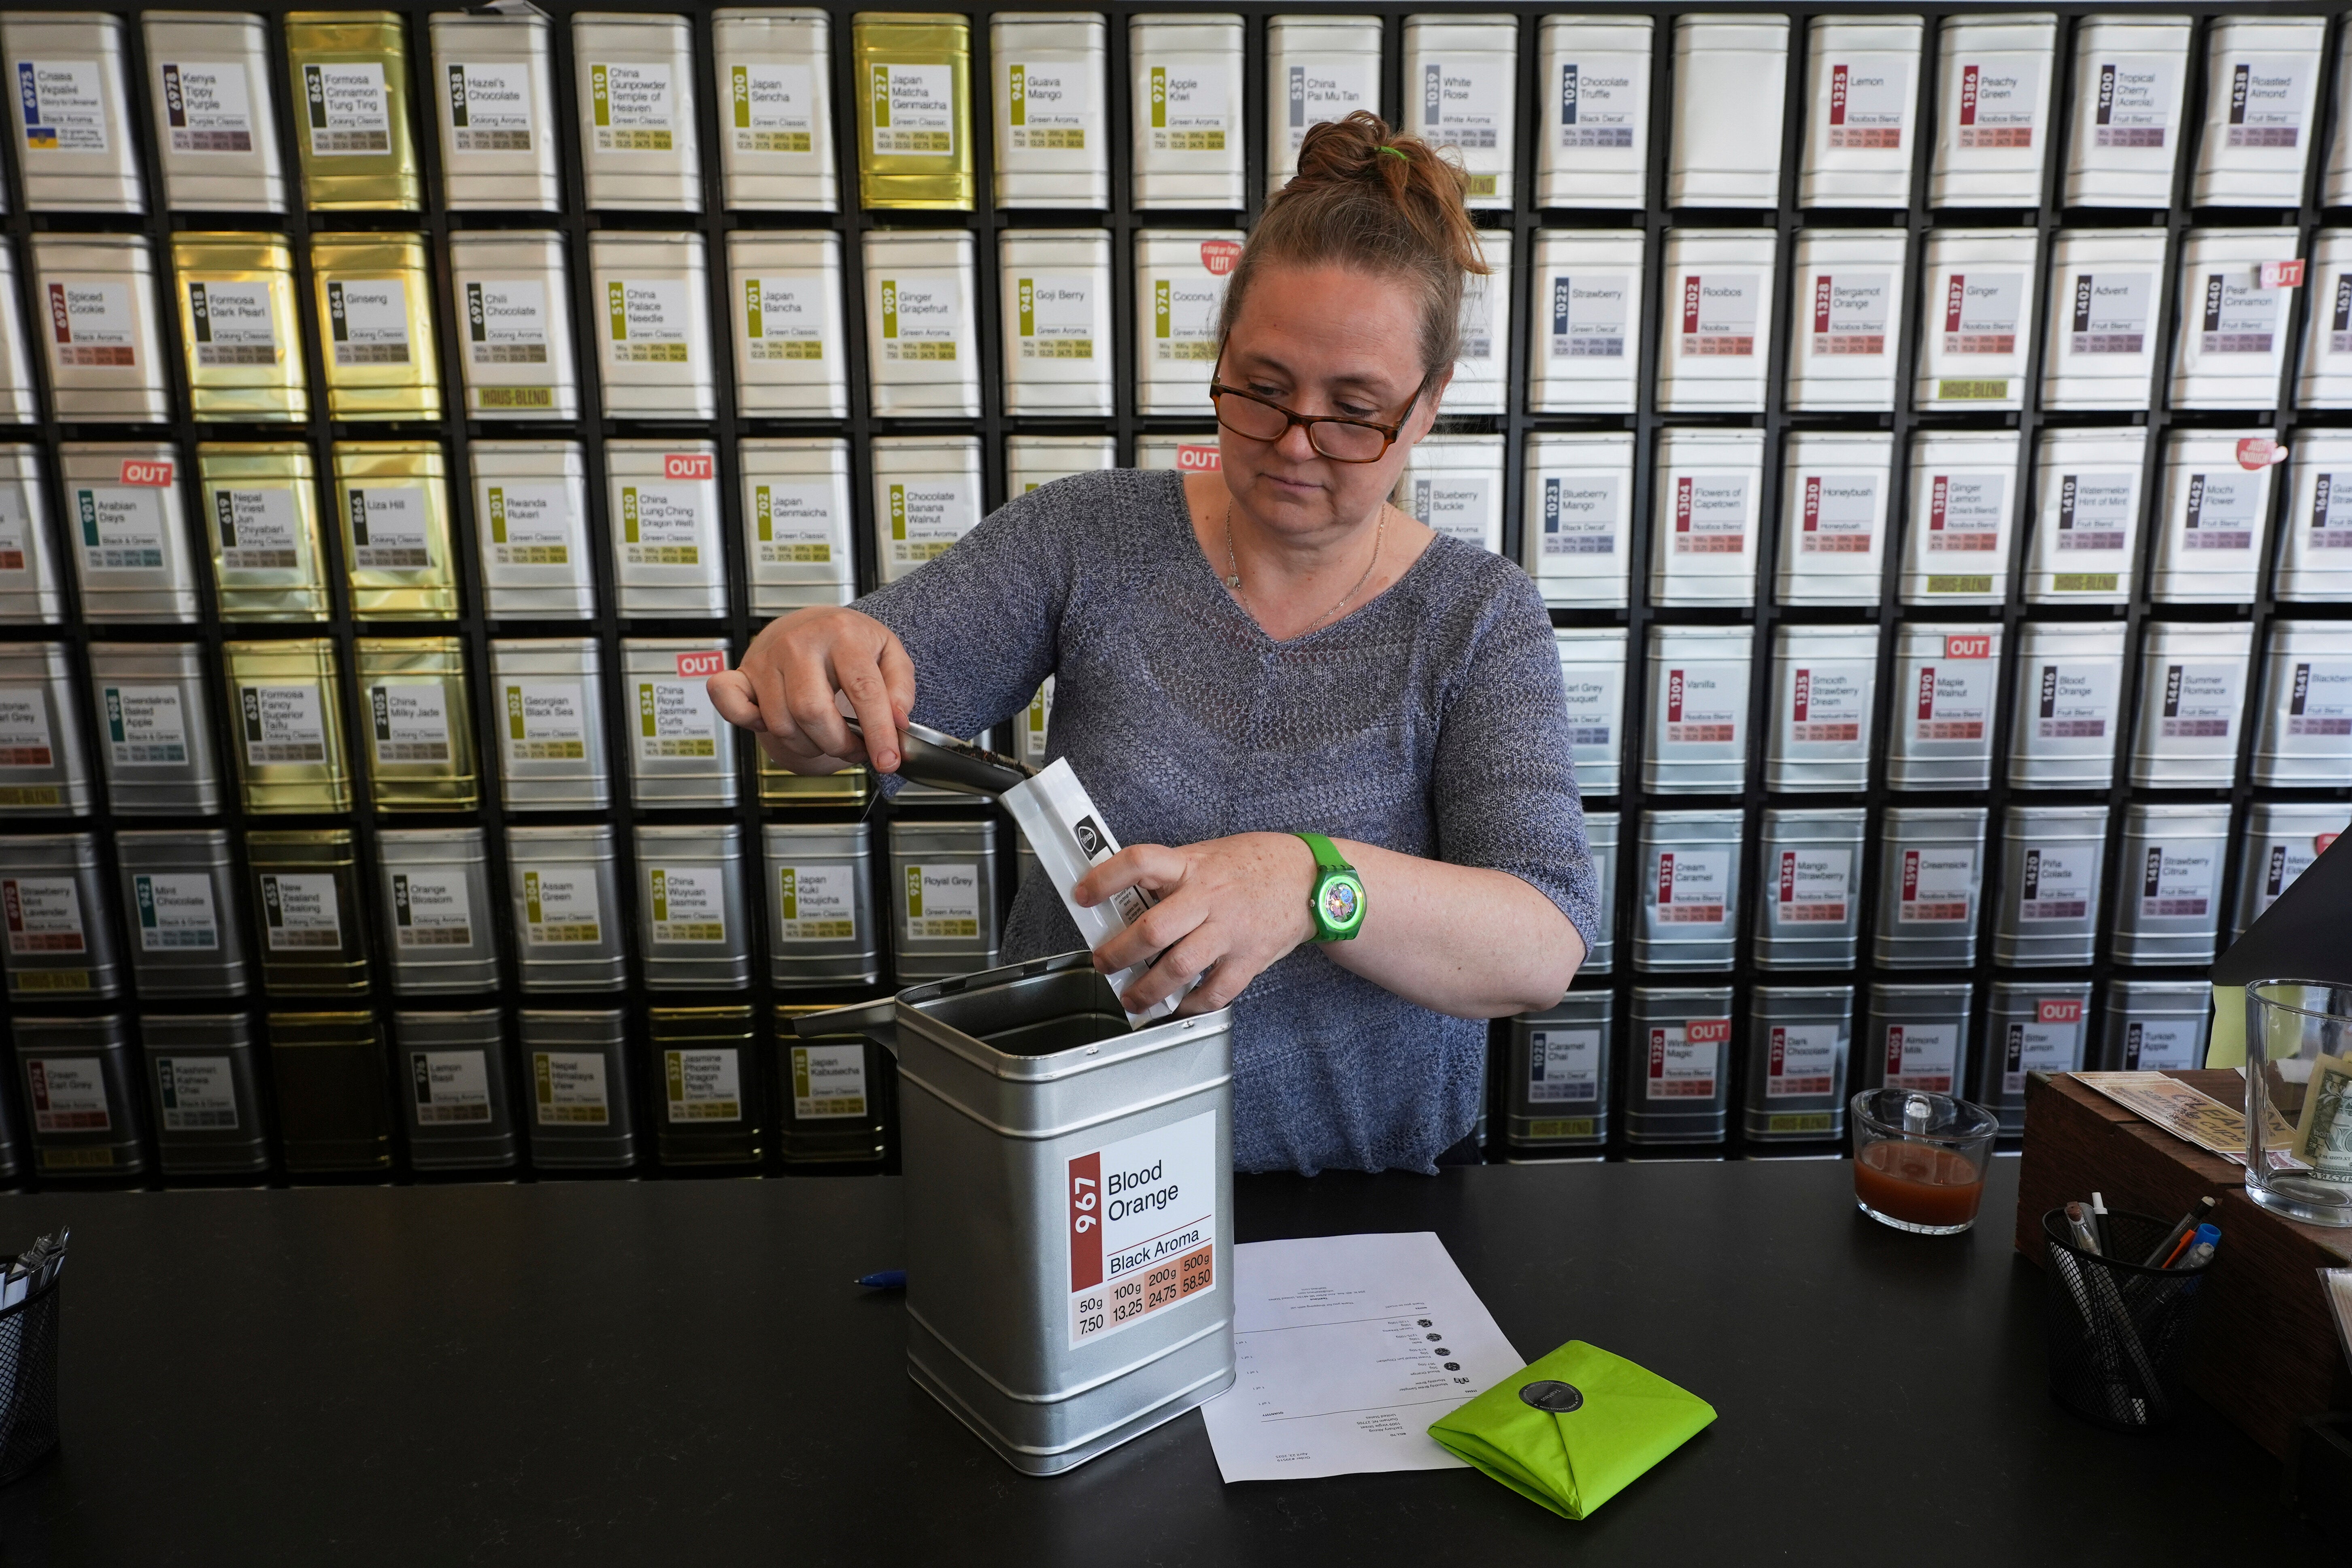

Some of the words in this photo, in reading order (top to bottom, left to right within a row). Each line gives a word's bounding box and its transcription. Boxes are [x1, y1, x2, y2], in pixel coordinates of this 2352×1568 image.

[610, 68, 640, 79] China
[183, 73, 216, 86] Kenya
[325, 74, 369, 85] Formosa
[610, 79, 666, 91] Gunpowder
[891, 76, 922, 86] Japan
[1028, 77, 1060, 87] Guava
[1169, 79, 1197, 91] Apple
[1580, 77, 1629, 87] Chocolate
[1850, 77, 1884, 86] Lemon
[1981, 77, 2018, 88] Peachy
[166, 72, 181, 111] 6978
[311, 74, 321, 102] 862
[452, 73, 464, 107] 1638
[595, 73, 606, 99] 510
[876, 74, 887, 101] 727
[1012, 73, 1023, 100] 945
[1153, 75, 1163, 103] 973
[1564, 73, 1576, 105] 1021
[1833, 73, 1846, 107] 1325
[1963, 74, 1978, 109] 1386
[184, 86, 213, 98] Tippy
[326, 87, 378, 98] Cinnamon
[468, 90, 520, 100] Chocolate
[612, 91, 648, 103] Temple
[651, 91, 661, 102] of
[892, 87, 929, 97] Matcha
[1028, 90, 1062, 101] Mango
[1170, 91, 1190, 100] Kiwi
[1581, 89, 1610, 99] Truffle
[1980, 89, 2011, 99] Green
[186, 98, 220, 111] Purple
[328, 100, 353, 112] Tung
[356, 99, 377, 112] Ting
[613, 104, 651, 113] Heaven
[892, 99, 947, 110] Genmaicha
[627, 289, 656, 300] China
[1036, 290, 1056, 301] Goji
[1059, 290, 1084, 301] Berry
[1173, 291, 1214, 301] Coconut
[1703, 287, 1742, 297] Rooibos
[1834, 287, 1880, 298] Bergamot
[485, 295, 507, 304] Chili
[612, 290, 623, 314] 512
[884, 288, 895, 314] 909
[900, 292, 931, 304] Ginger
[1021, 286, 1031, 313] 948
[1157, 289, 1168, 314] 974
[1686, 284, 1699, 316] 1302
[1817, 283, 1830, 317] 1328
[1833, 298, 1869, 309] Orange
[470, 290, 483, 323] 6971
[486, 306, 536, 316] Chocolate
[628, 301, 661, 311] Palace
[900, 304, 947, 314] Grapefruit
[629, 313, 663, 323] Needle
[483, 389, 549, 405] HAUS-BLEND
[127, 464, 168, 483] OUT
[669, 460, 708, 476] OUT
[907, 492, 955, 501] Chocolate
[1563, 490, 1608, 500] Blueberry
[1695, 488, 1729, 497] Flowers
[1732, 487, 1742, 497] of
[507, 498, 547, 508] Rwanda
[640, 495, 667, 504] China
[773, 497, 802, 507] Japan
[1547, 486, 1559, 517] 1023
[1678, 485, 1691, 517] 1304
[1694, 499, 1740, 509] Capetown
[2063, 482, 2076, 515] 1410
[2078, 497, 2096, 506] Hint
[2099, 497, 2108, 506] of
[2109, 497, 2127, 505] Mint
[491, 494, 502, 517] 301
[625, 495, 636, 519] 520
[759, 494, 769, 517] 702
[893, 492, 903, 517] 919
[908, 504, 944, 513] Banana
[1563, 501, 1594, 512] Mango
[640, 507, 664, 517] Lung
[666, 506, 693, 518] Ching
[774, 508, 827, 518] Genmaicha
[908, 515, 941, 523] Walnut
[1950, 640, 1987, 655] OUT
[682, 656, 720, 673] OUT
[1686, 680, 1716, 689] Vanilla
[1813, 676, 1847, 685] Smooth
[1670, 677, 1682, 707] 1309
[1796, 676, 1809, 706] 1335
[1812, 687, 1859, 696] Strawberry
[389, 697, 417, 707] China
[525, 696, 568, 707] Georgian
[1811, 697, 1841, 706] Dream
[374, 693, 388, 725] 2105
[391, 708, 415, 718] Milky
[418, 708, 440, 717] Jade
[525, 708, 551, 717] Black
[555, 708, 574, 717] Sea
[1676, 863, 1705, 872] Cream
[1797, 862, 1828, 872] Mango
[1661, 860, 1672, 887] 1312
[1675, 874, 1713, 882] Caramel
[1782, 859, 1795, 888] 1345
[1797, 872, 1844, 882] Strawberry
[783, 875, 794, 897] 716
[798, 876, 827, 886] Japan
[910, 874, 920, 896] 925
[925, 877, 950, 886] Royal
[952, 876, 973, 887] Grey
[798, 886, 819, 894] Kuki
[1548, 1042, 1585, 1052] Caramel
[1533, 1040, 1544, 1067] 1028
[1548, 1052, 1568, 1061] Chai
[810, 1059, 838, 1068] Japan
[1108, 1160, 1162, 1196] Blood
[1075, 1177, 1096, 1233] 967
[1108, 1185, 1178, 1221] Orange
[1111, 1247, 1150, 1274] Black
[1155, 1230, 1199, 1257] Aroma
[1080, 1298, 1103, 1313] 50g
[1114, 1283, 1141, 1300] 100g
[1149, 1268, 1176, 1286] 200g
[1184, 1254, 1210, 1272] 500g
[1080, 1315, 1103, 1335] 7.50
[1113, 1299, 1142, 1322] 13.25
[1149, 1284, 1176, 1308] 24.75
[1183, 1270, 1210, 1293] 58.50
